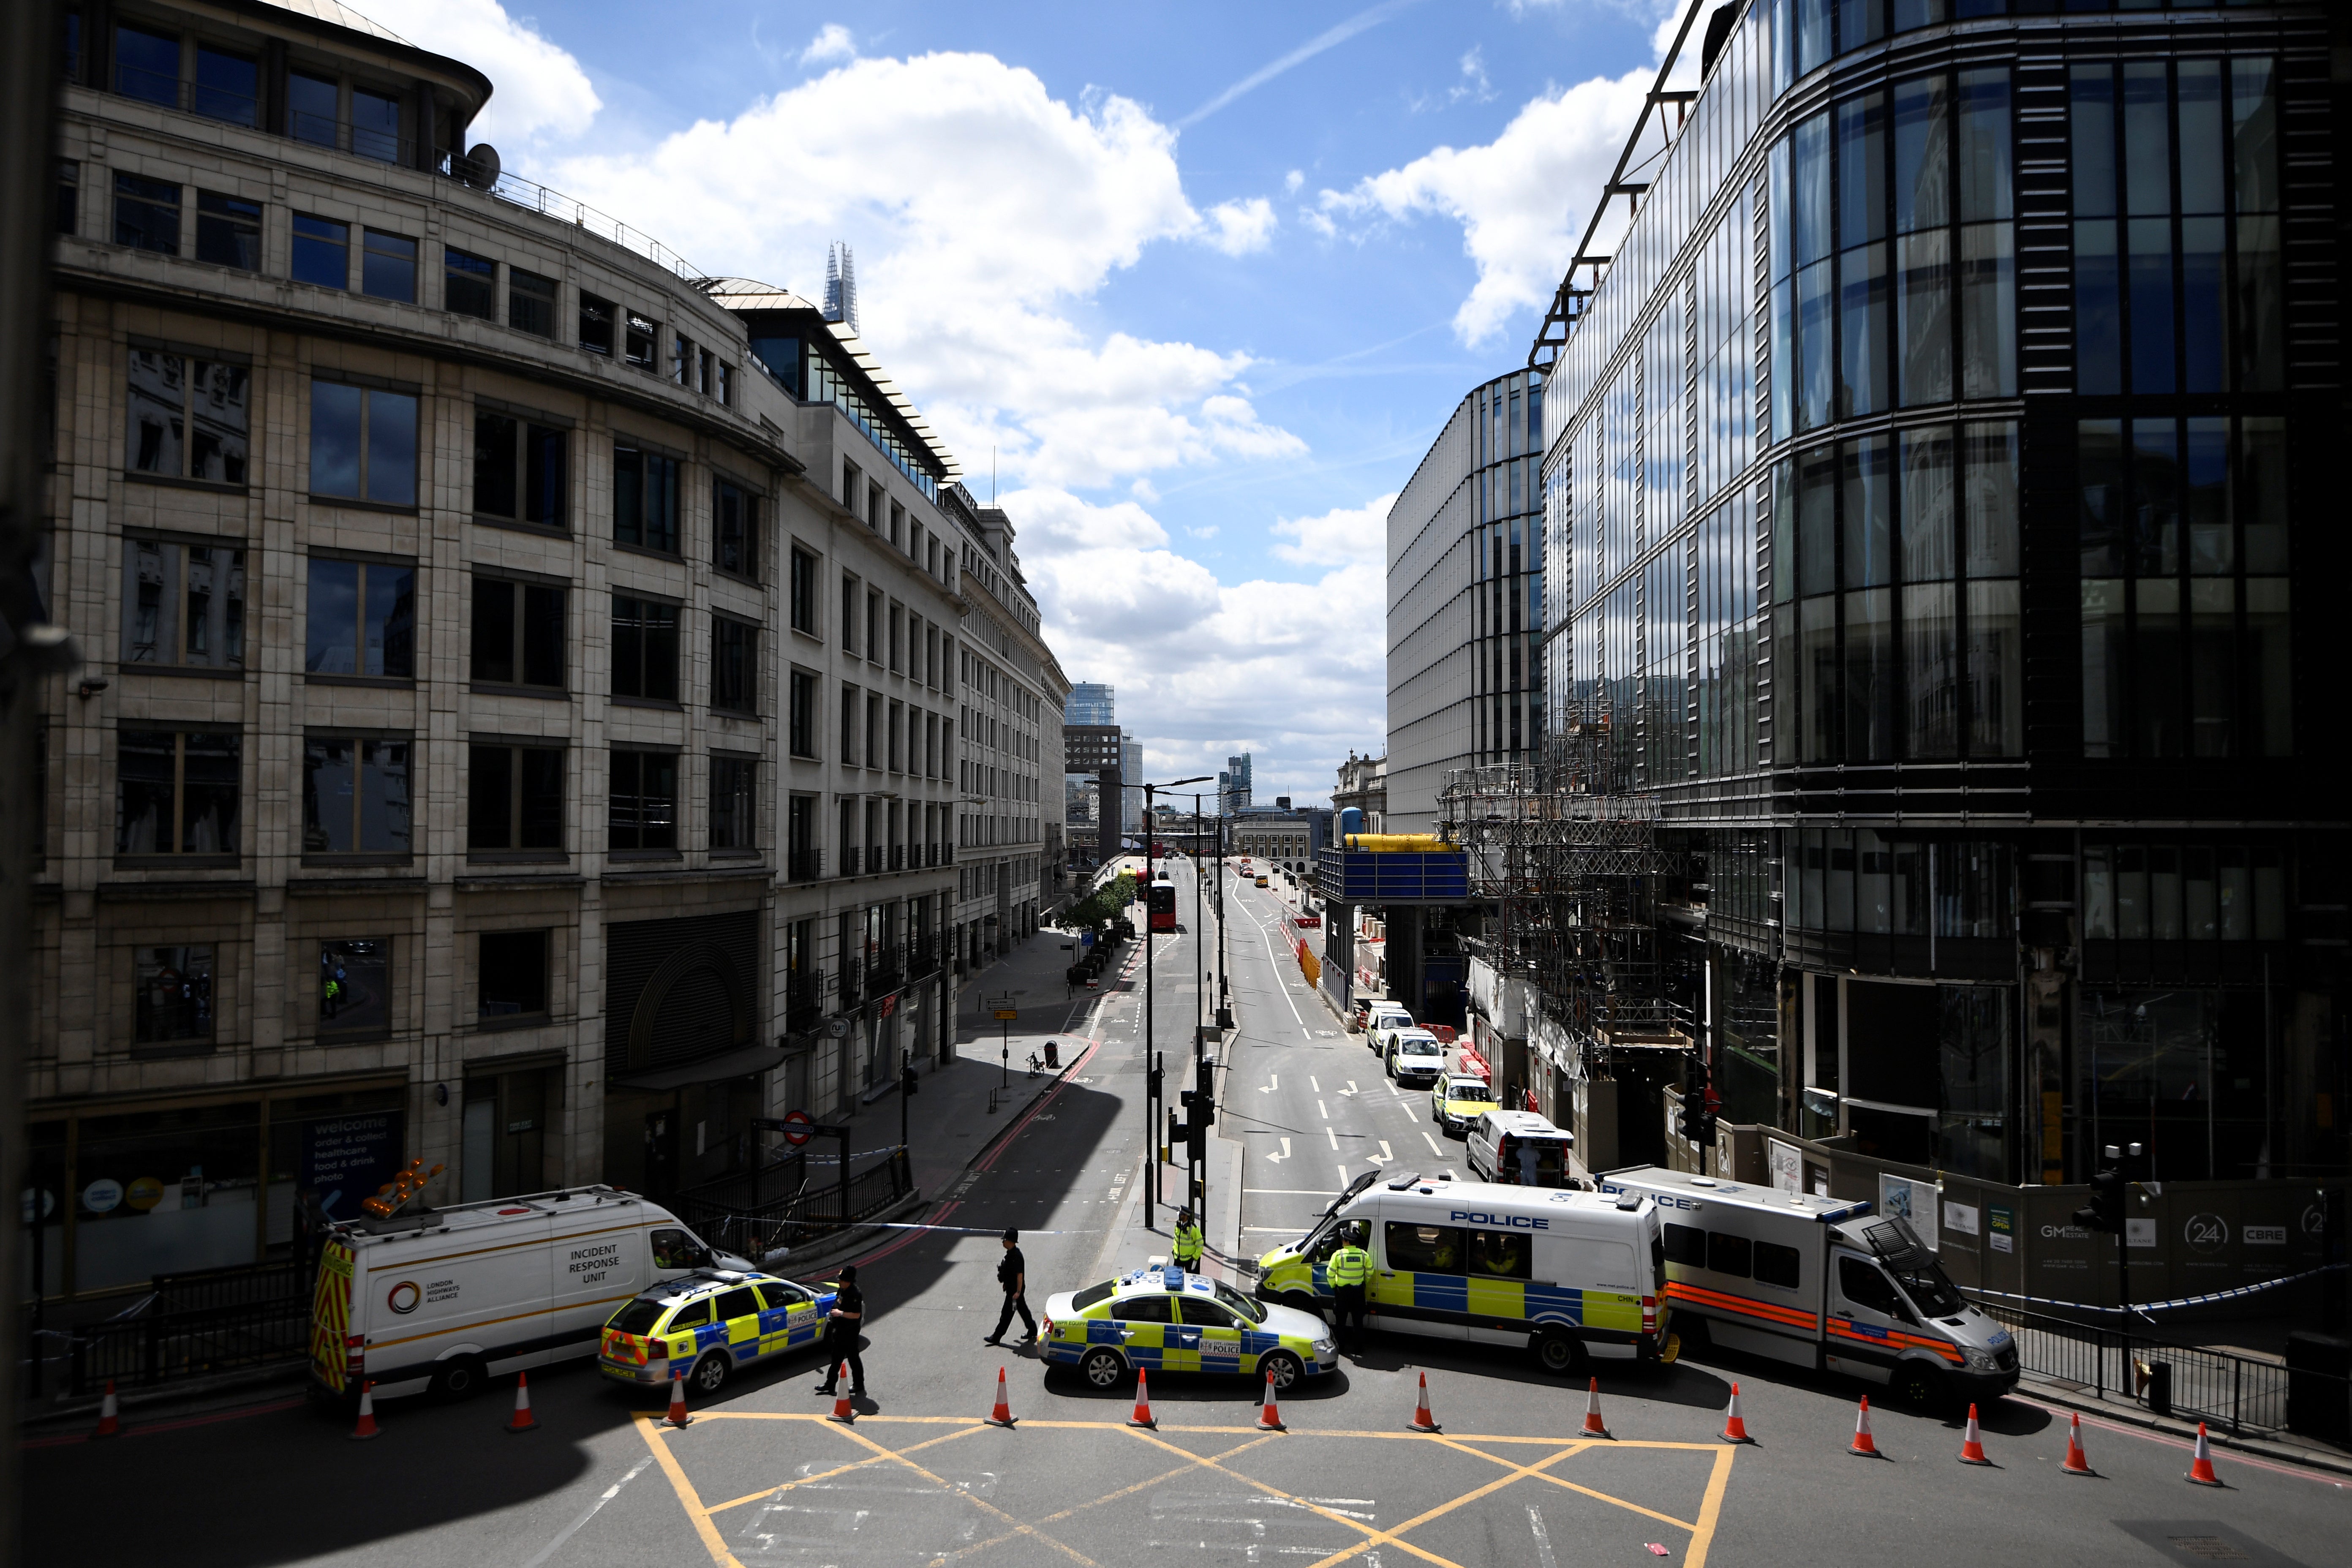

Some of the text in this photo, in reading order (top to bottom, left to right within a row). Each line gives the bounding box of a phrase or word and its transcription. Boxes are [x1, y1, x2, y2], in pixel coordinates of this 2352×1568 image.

[315, 1118, 387, 1134] welcome
[316, 1138, 343, 1147] order
[355, 1132, 387, 1141] collect
[315, 1146, 367, 1159] healthcare
[315, 1161, 338, 1171] food
[351, 1157, 375, 1167] drink
[315, 1173, 344, 1184] photo
[1114, 1173, 1128, 1184] LEFT
[1603, 1184, 1690, 1211] PICE
[1451, 1211, 1549, 1229] POLICE
[1992, 1221, 2010, 1230] OPEN
[2041, 1225, 2065, 1237] GM
[2193, 1223, 2220, 1242] 24
[2246, 1230, 2282, 1239] CBRE
[572, 1244, 617, 1260] INCIDENT
[570, 1257, 619, 1273] RESPONSE
[583, 1271, 606, 1283] UNIT
[427, 1279, 453, 1289] LONDON
[427, 1285, 460, 1296] HIGHWAYS
[427, 1292, 458, 1303] ALLIANCE
[798, 1312, 817, 1323] POLICE
[1214, 1345, 1240, 1353] POLICE
[602, 1364, 635, 1377] POLICE
